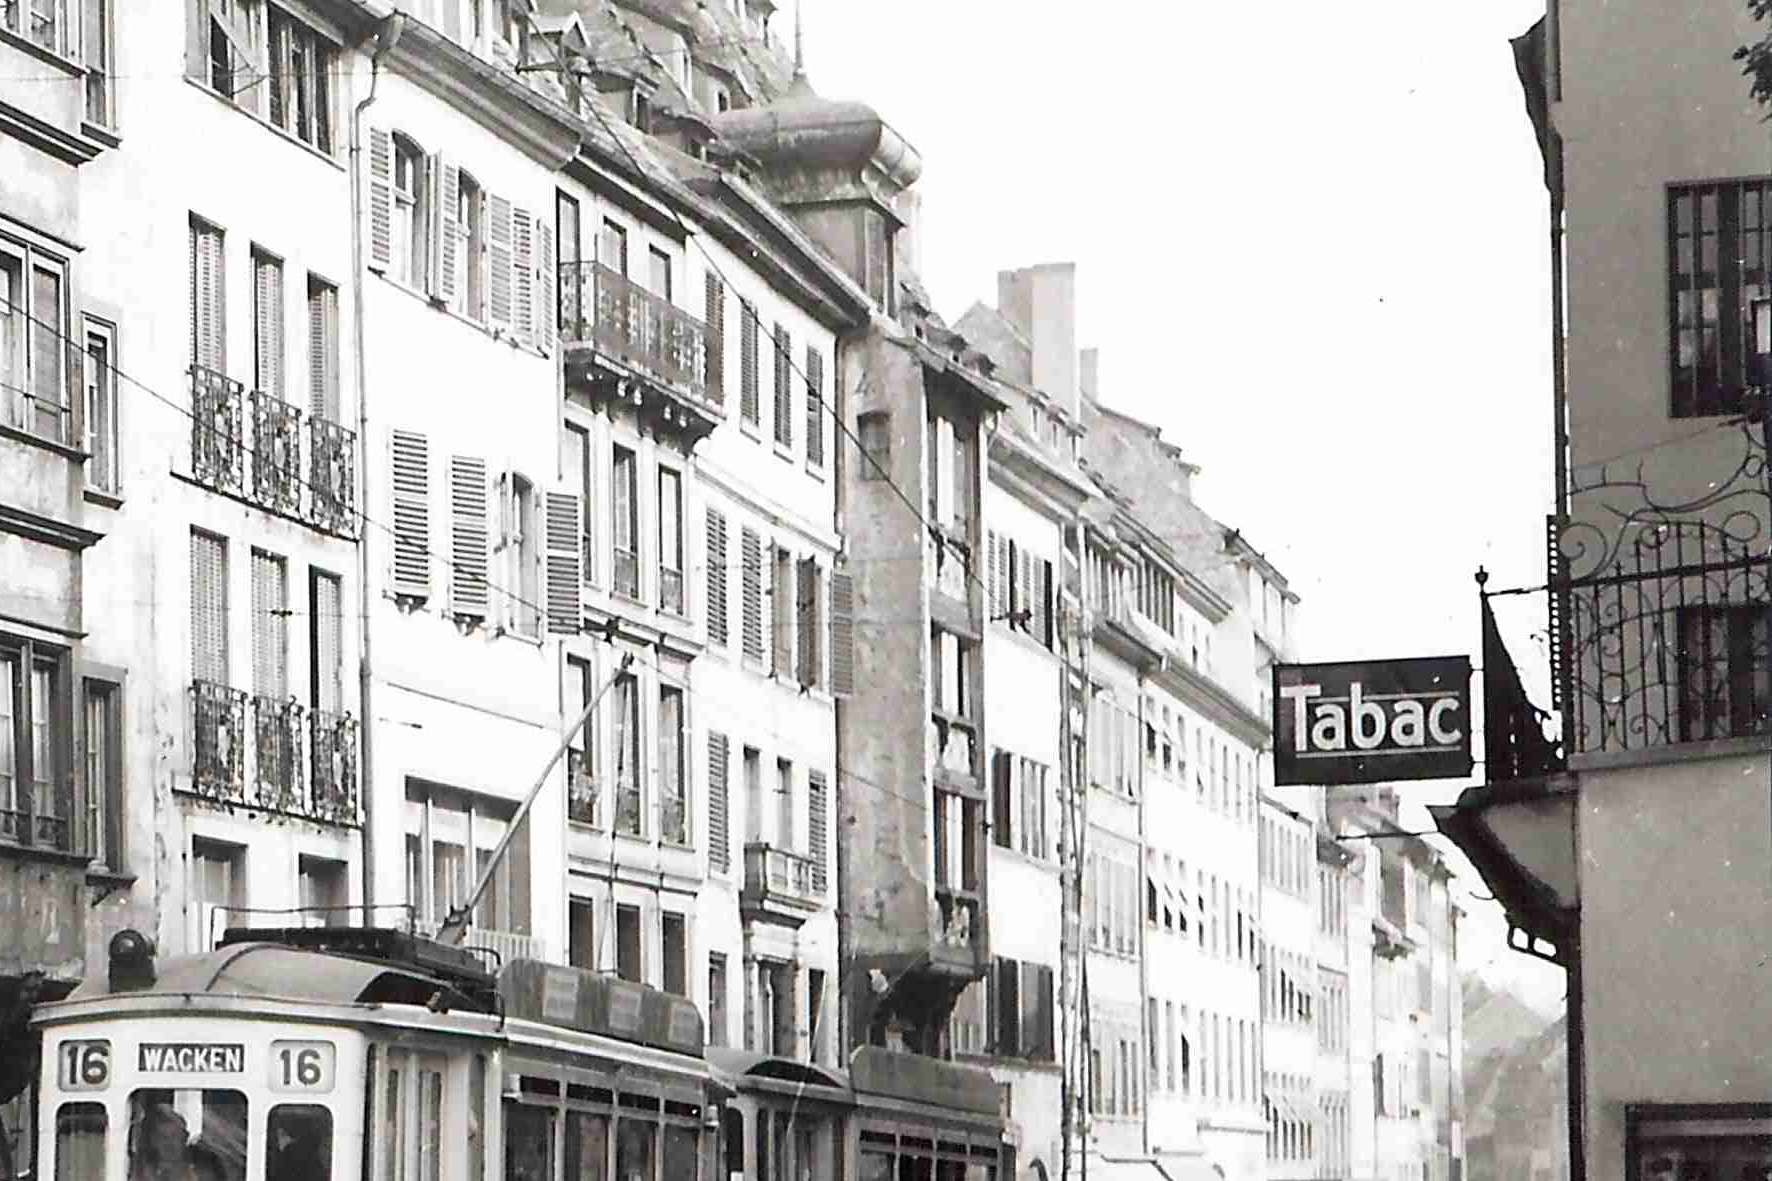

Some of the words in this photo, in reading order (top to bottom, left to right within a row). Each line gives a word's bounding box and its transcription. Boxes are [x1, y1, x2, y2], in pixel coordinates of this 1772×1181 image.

[1280, 681, 1462, 751] Tabac
[67, 1046, 109, 1085] 16
[142, 1047, 241, 1073] WACKEN
[279, 1048, 322, 1086] 16
